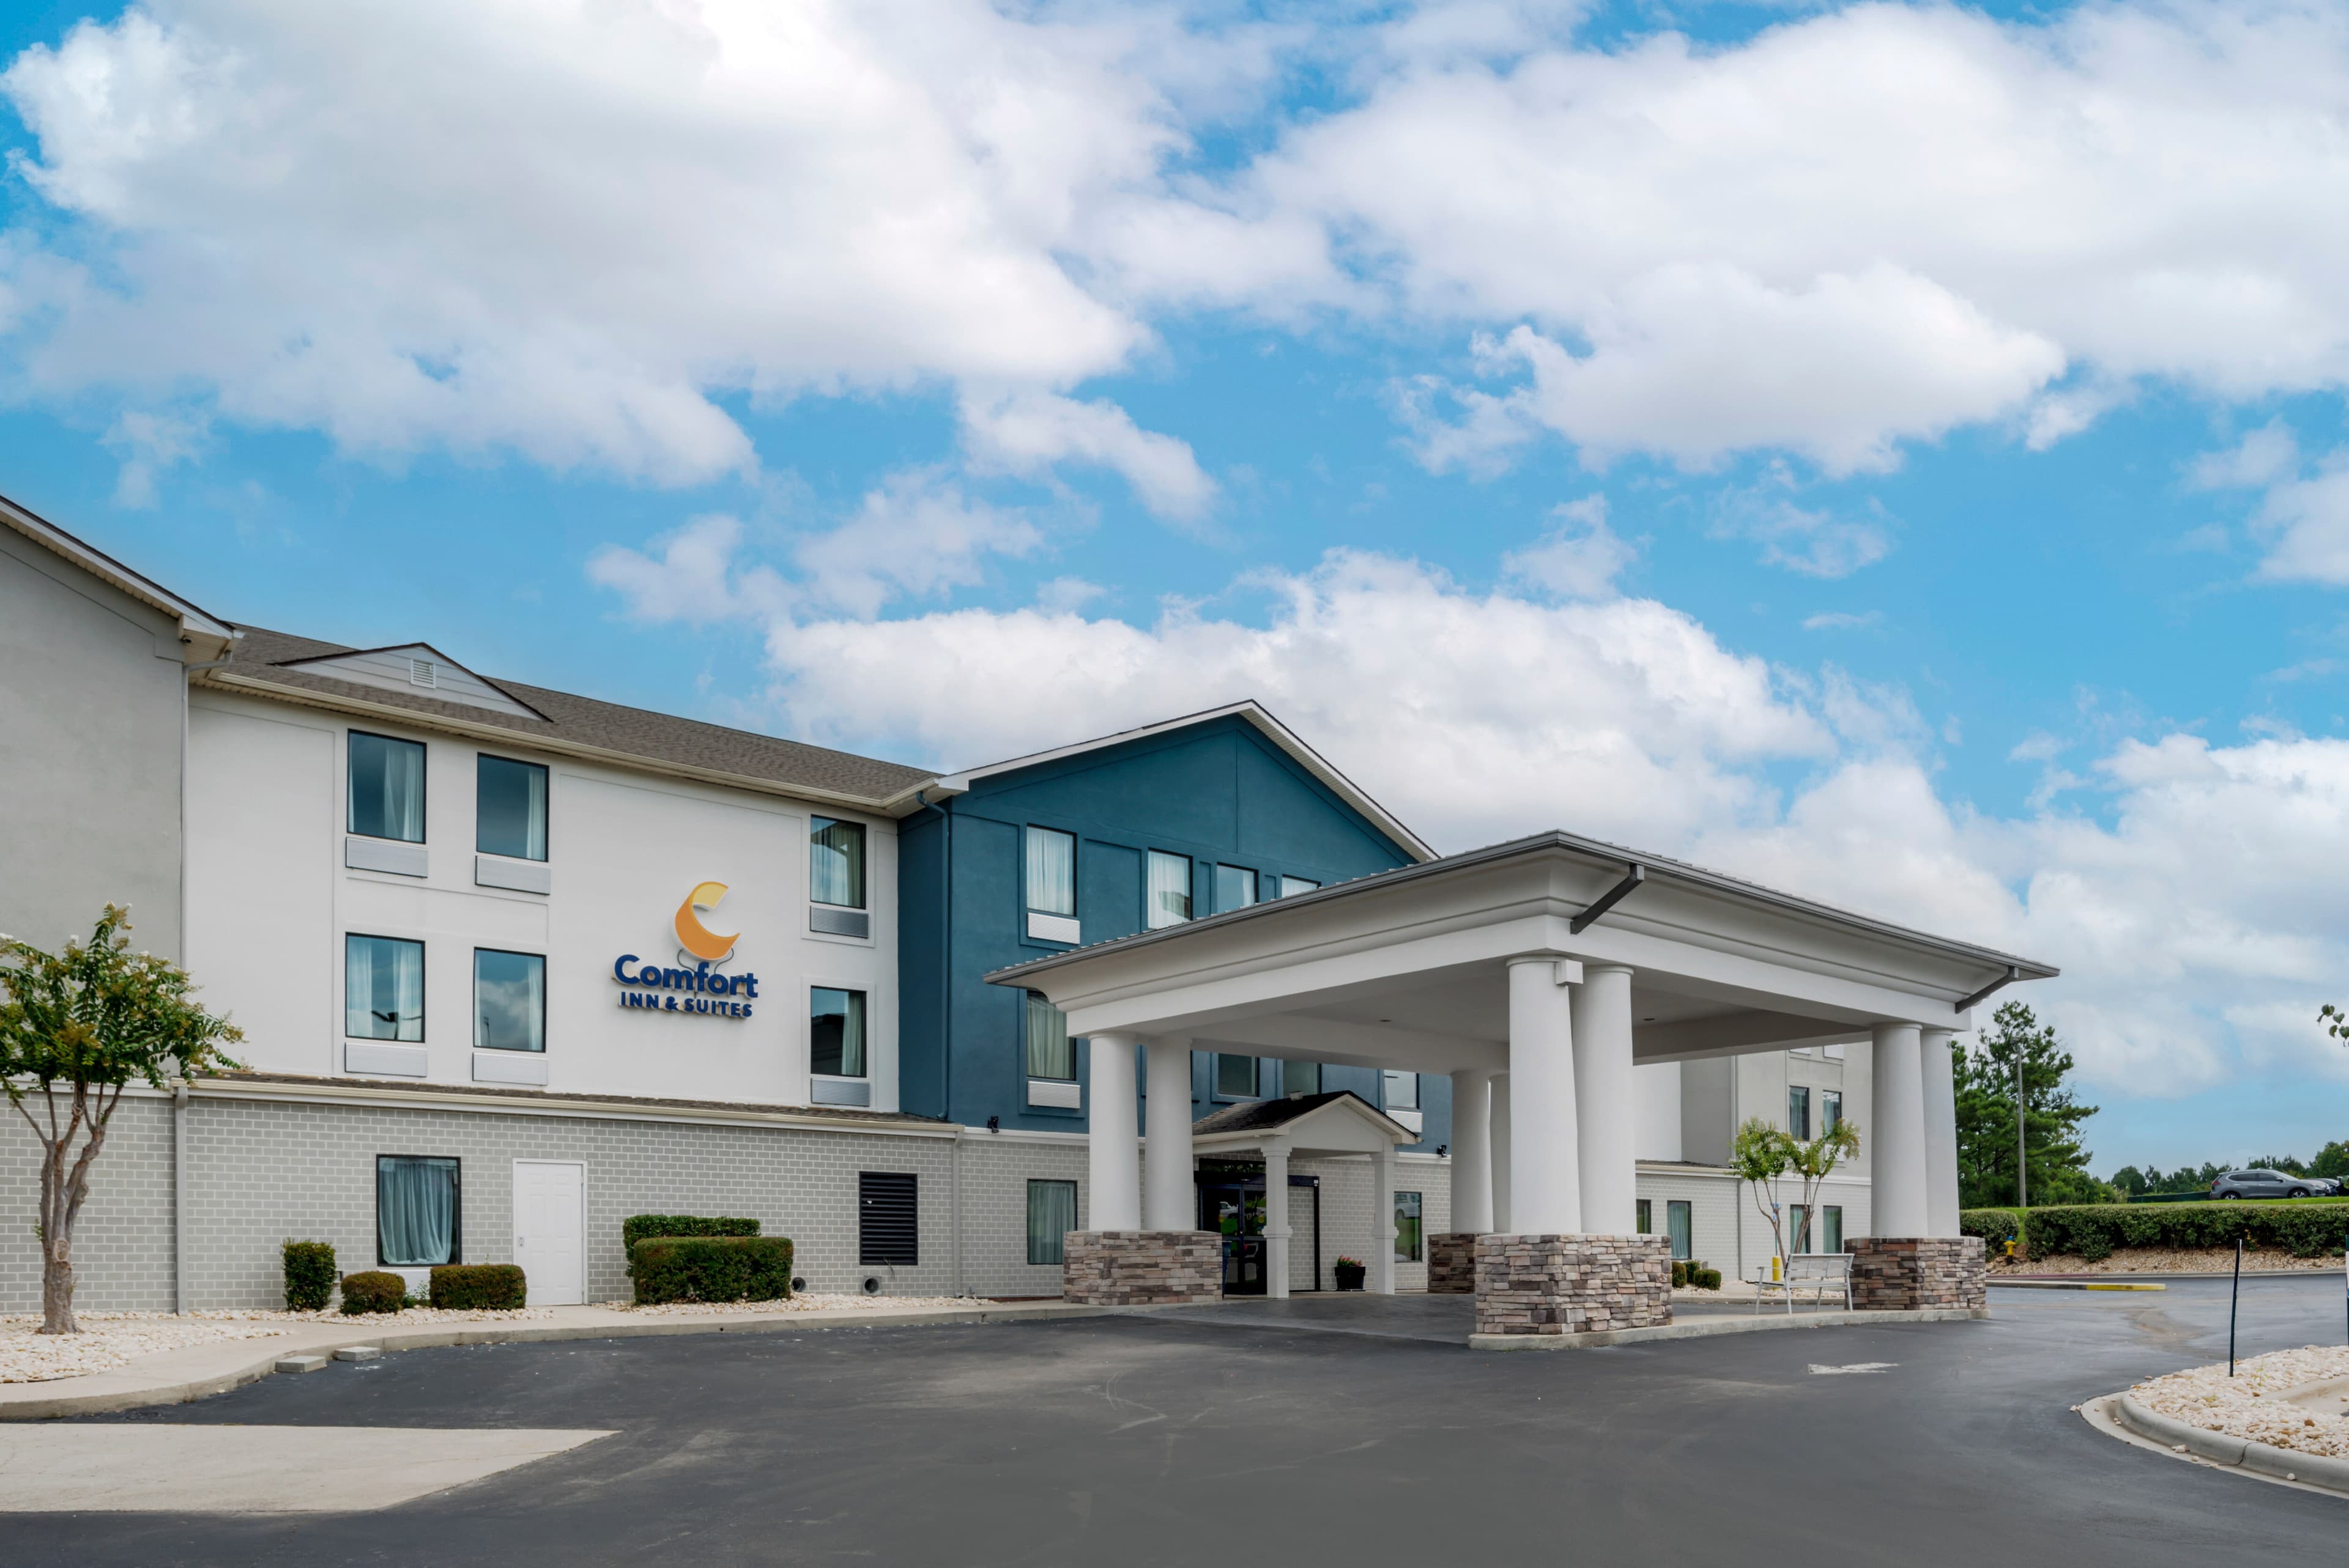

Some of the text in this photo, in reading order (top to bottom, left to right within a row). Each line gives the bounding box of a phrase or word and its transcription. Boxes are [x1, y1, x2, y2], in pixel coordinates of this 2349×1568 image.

[614, 954, 758, 998] Comfort
[621, 991, 752, 1018] INN & SUITES
